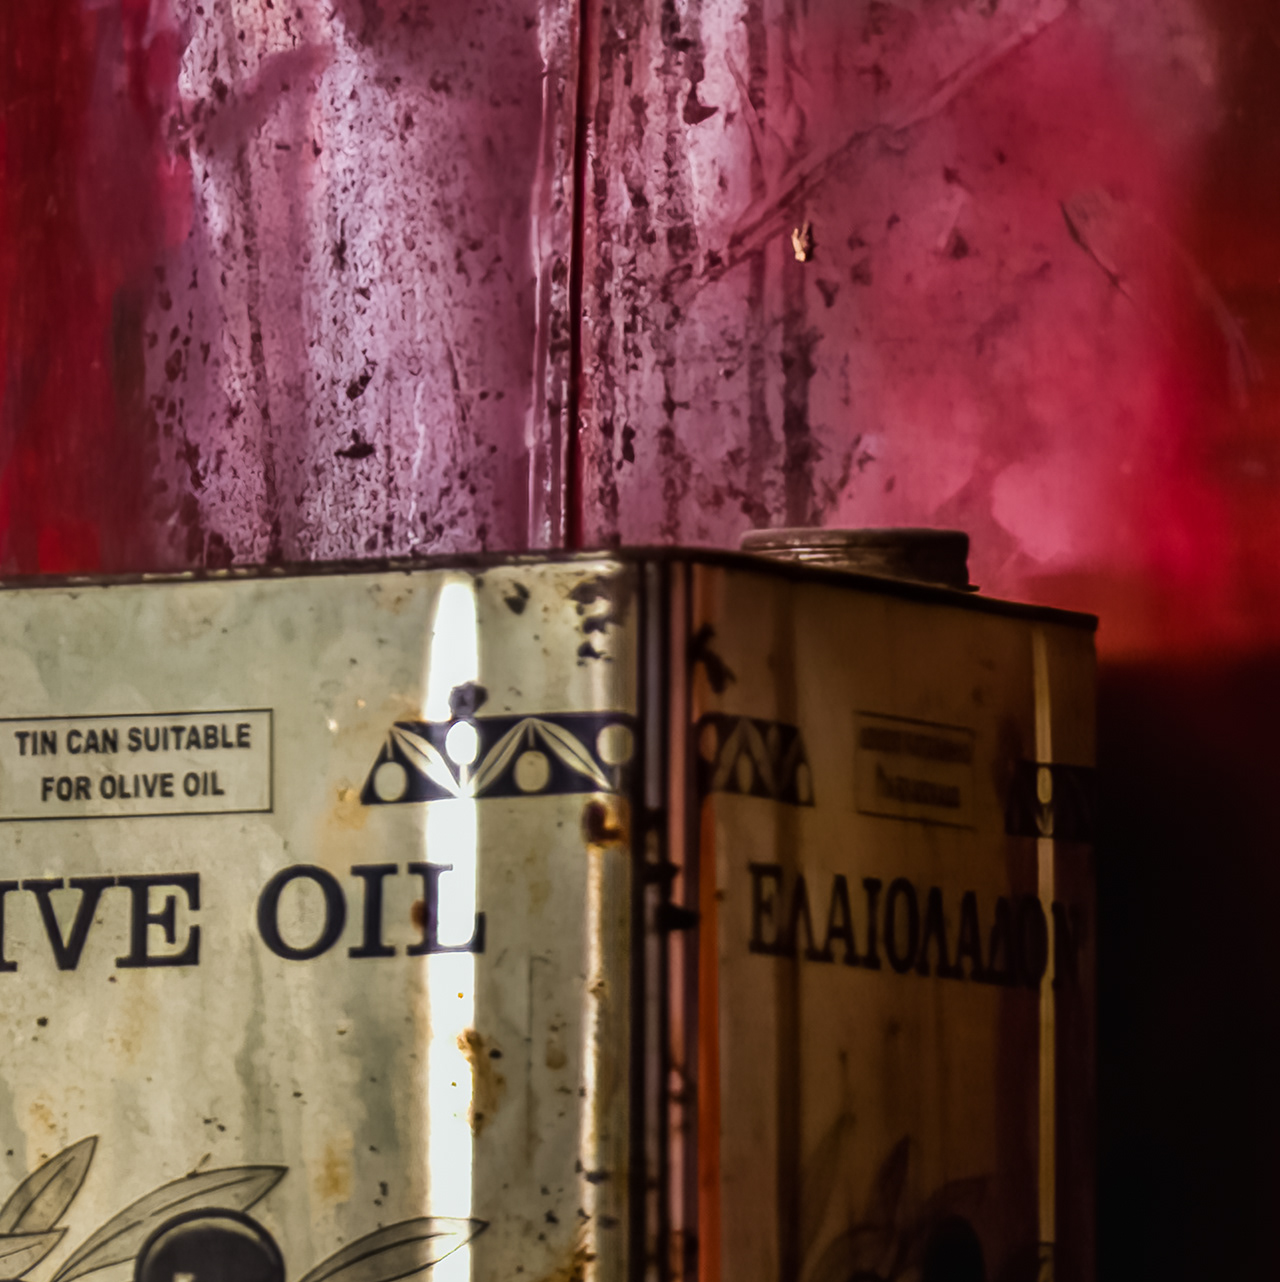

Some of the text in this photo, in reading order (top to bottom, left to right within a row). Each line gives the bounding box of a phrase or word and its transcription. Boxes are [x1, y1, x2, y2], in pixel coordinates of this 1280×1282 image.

[14, 721, 252, 758] TIN CAN SUITABLE
[40, 769, 227, 804] FOR OLIVE OIL
[256, 862, 486, 965] OIL
